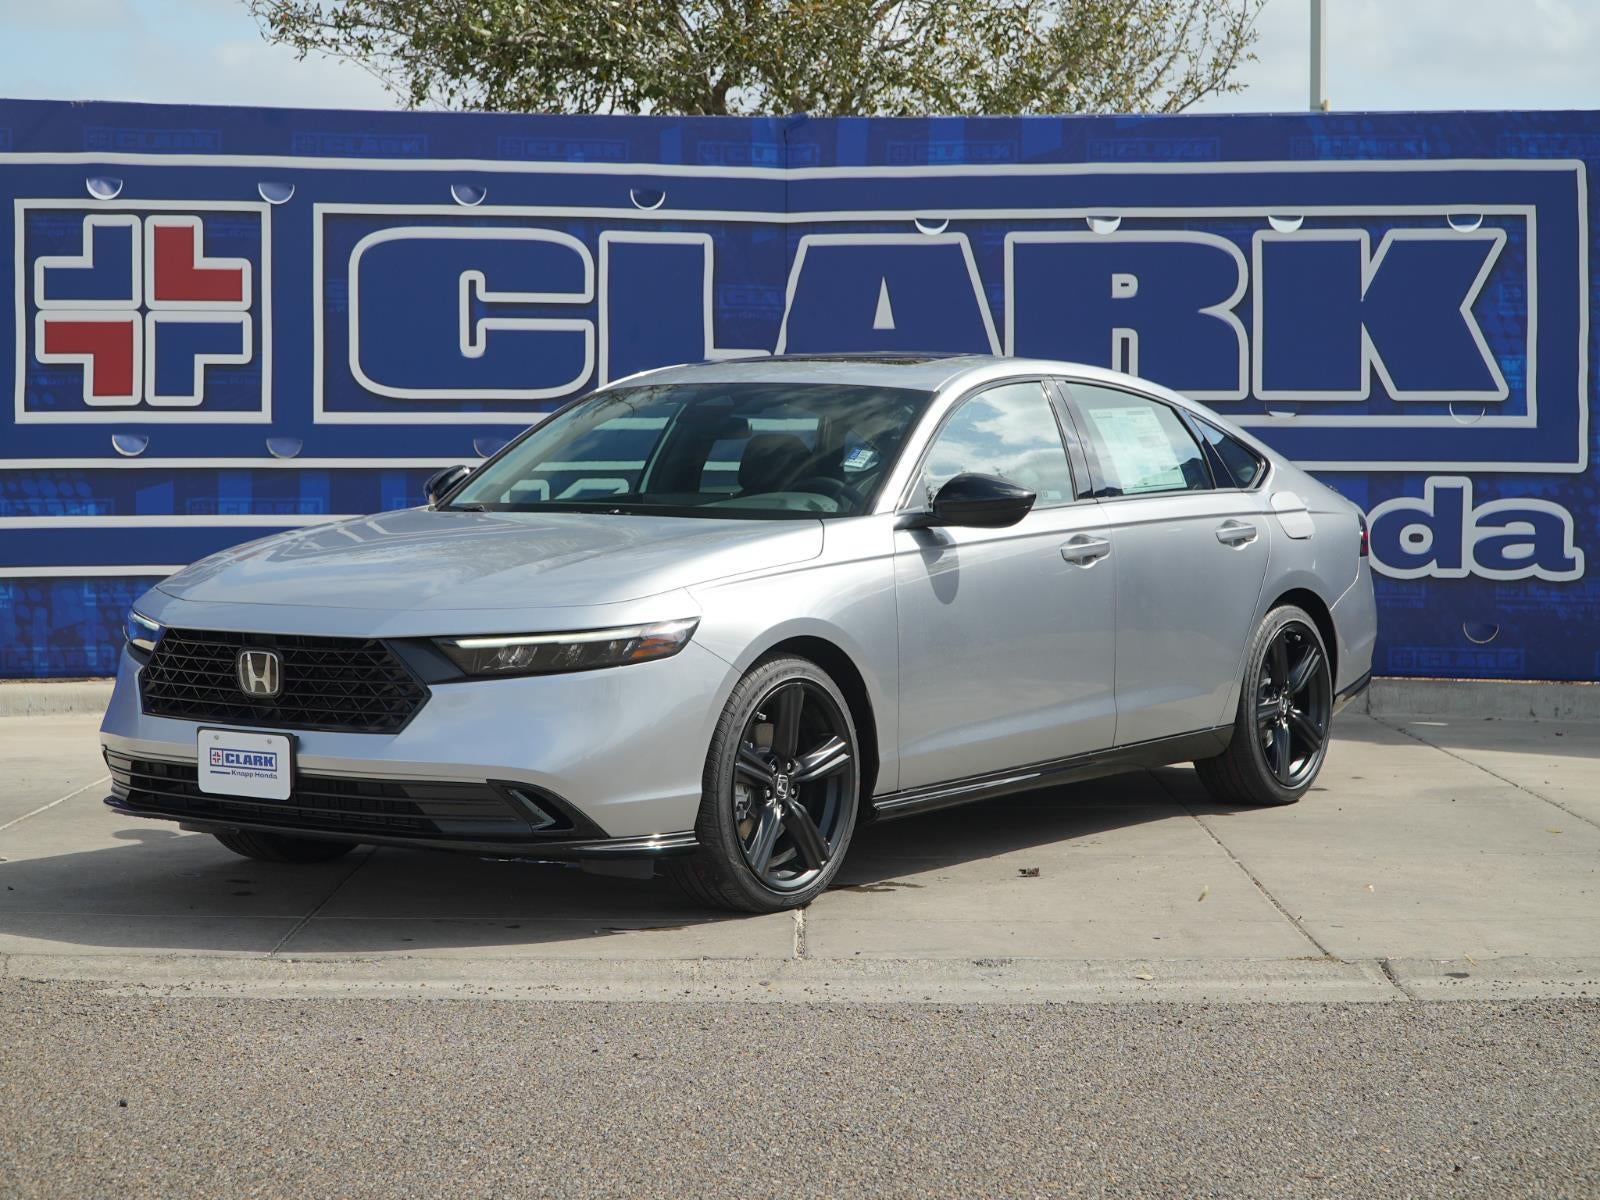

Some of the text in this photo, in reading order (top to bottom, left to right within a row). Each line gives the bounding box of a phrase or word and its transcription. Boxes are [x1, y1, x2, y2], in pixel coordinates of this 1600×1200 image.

[348, 226, 1509, 402] CLARK
[225, 753, 274, 767] CLARK
[231, 769, 278, 779] Knapp Honda
